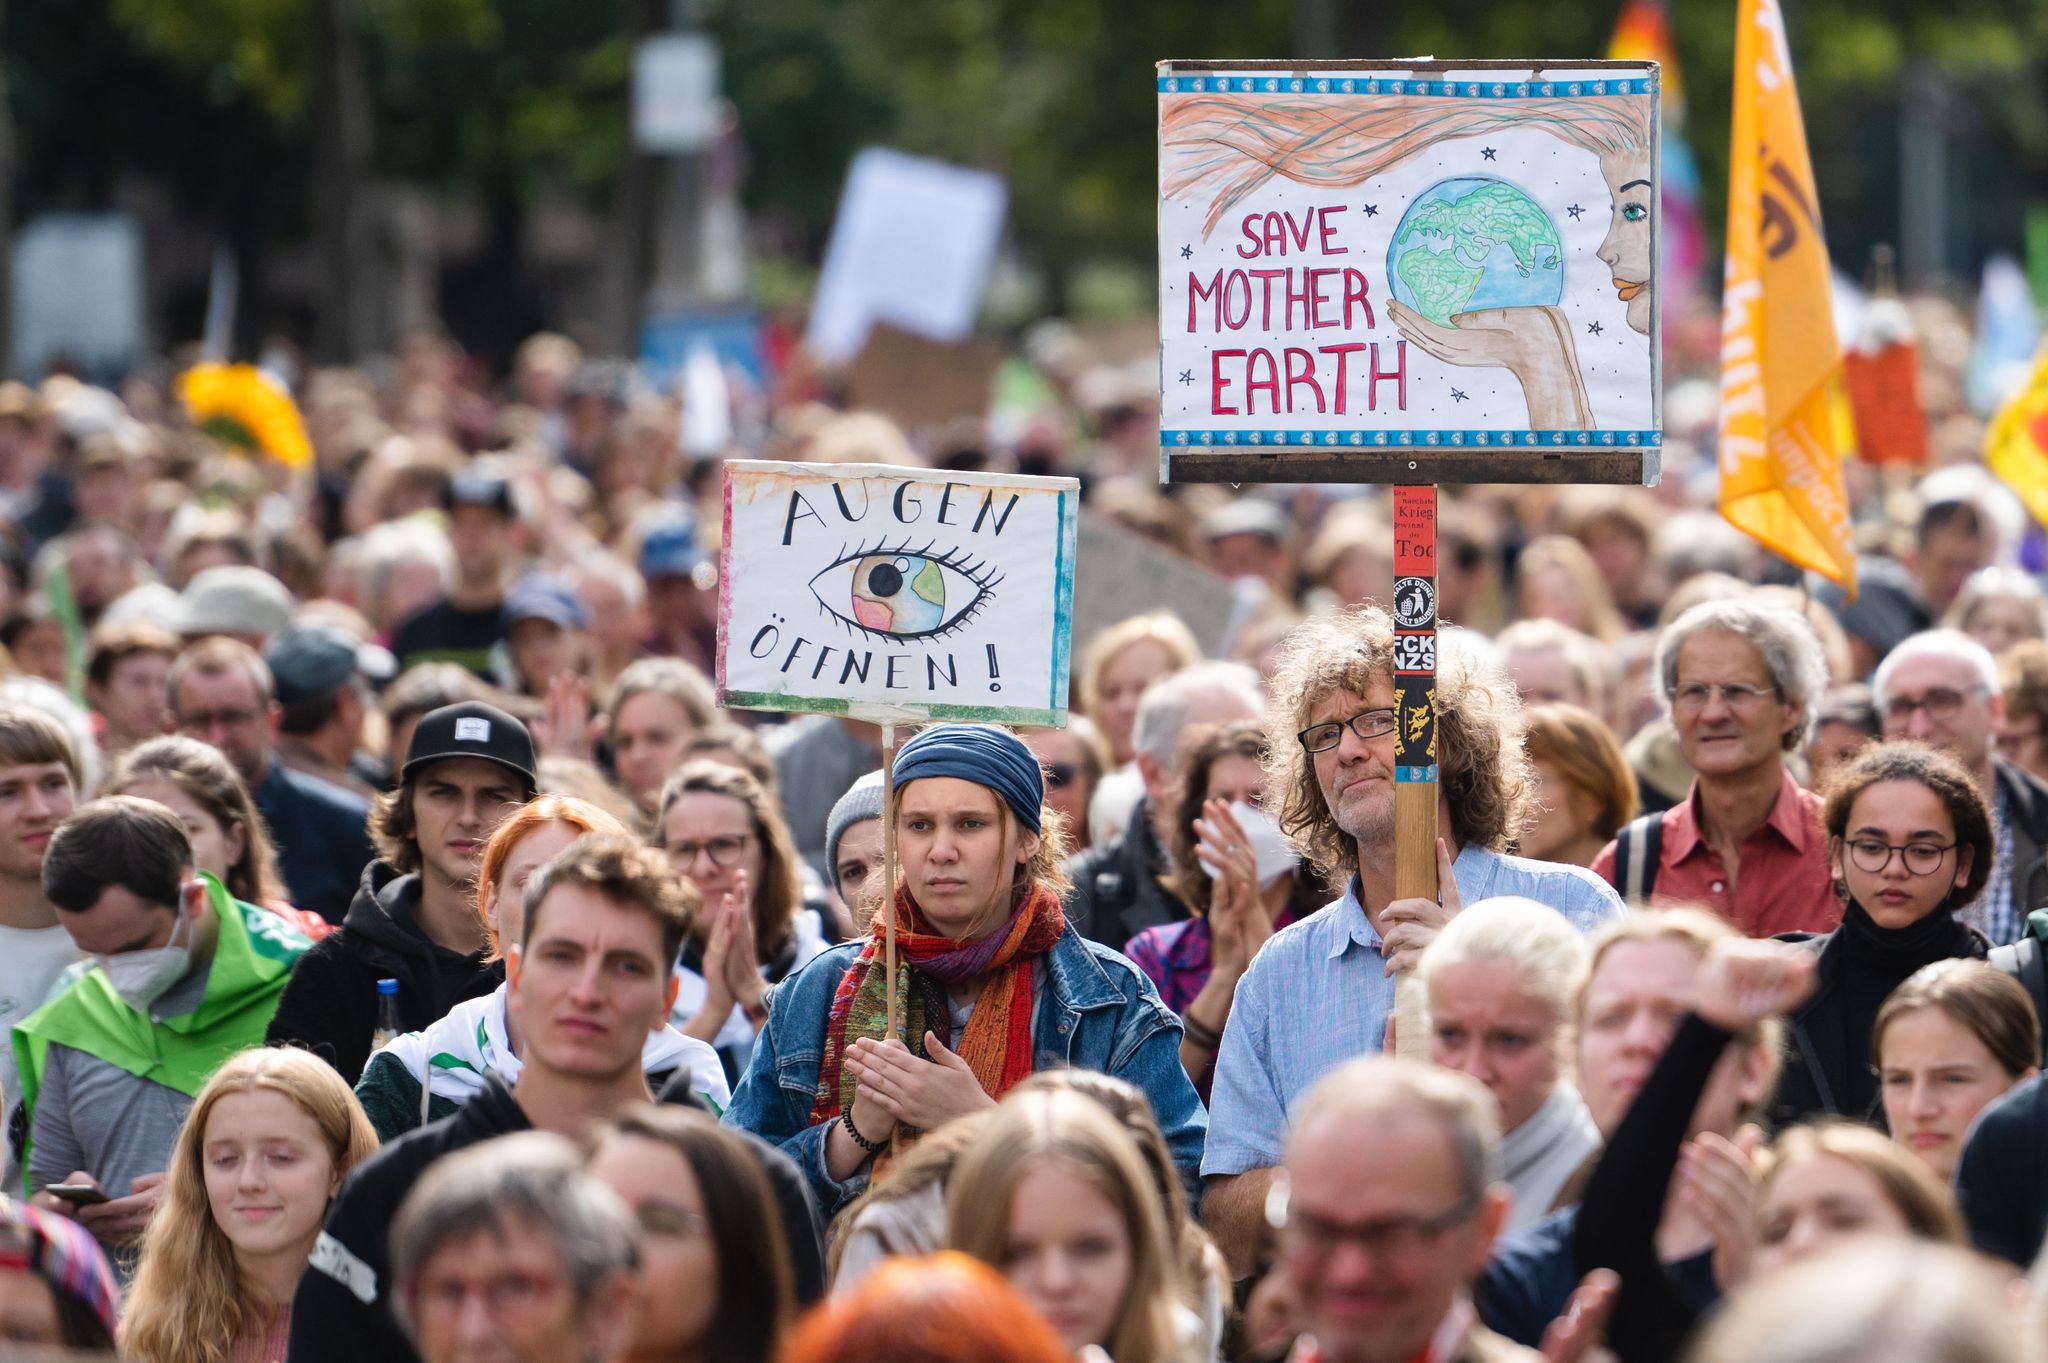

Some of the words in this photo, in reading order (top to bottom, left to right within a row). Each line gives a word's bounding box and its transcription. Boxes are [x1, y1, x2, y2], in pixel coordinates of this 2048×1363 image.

[1236, 205, 1348, 260] SAVE
[1187, 266, 1375, 333] MOTHER
[1211, 340, 1407, 416] EARTH
[781, 477, 1020, 546] AUGEN
[1399, 506, 1434, 520] Krieg
[1414, 580, 1433, 599] DEINE
[1394, 653, 1435, 671] NZS
